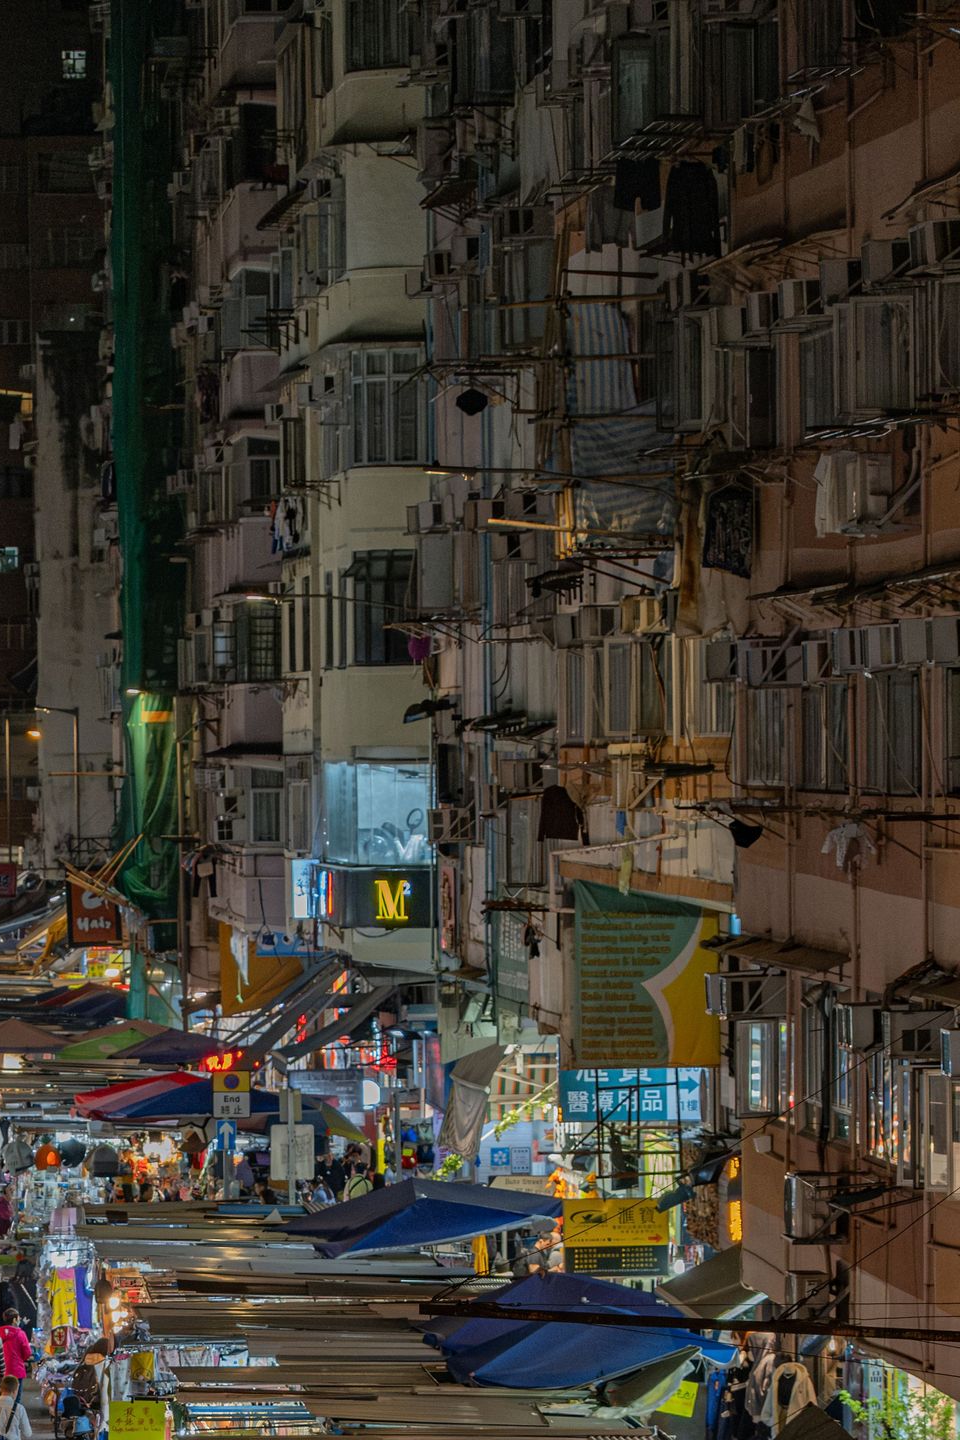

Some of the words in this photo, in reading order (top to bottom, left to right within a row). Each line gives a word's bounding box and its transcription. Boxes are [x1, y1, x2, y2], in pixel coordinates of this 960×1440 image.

[223, 1094, 240, 1103] End
[567, 1090, 663, 1113] 醫療用品
